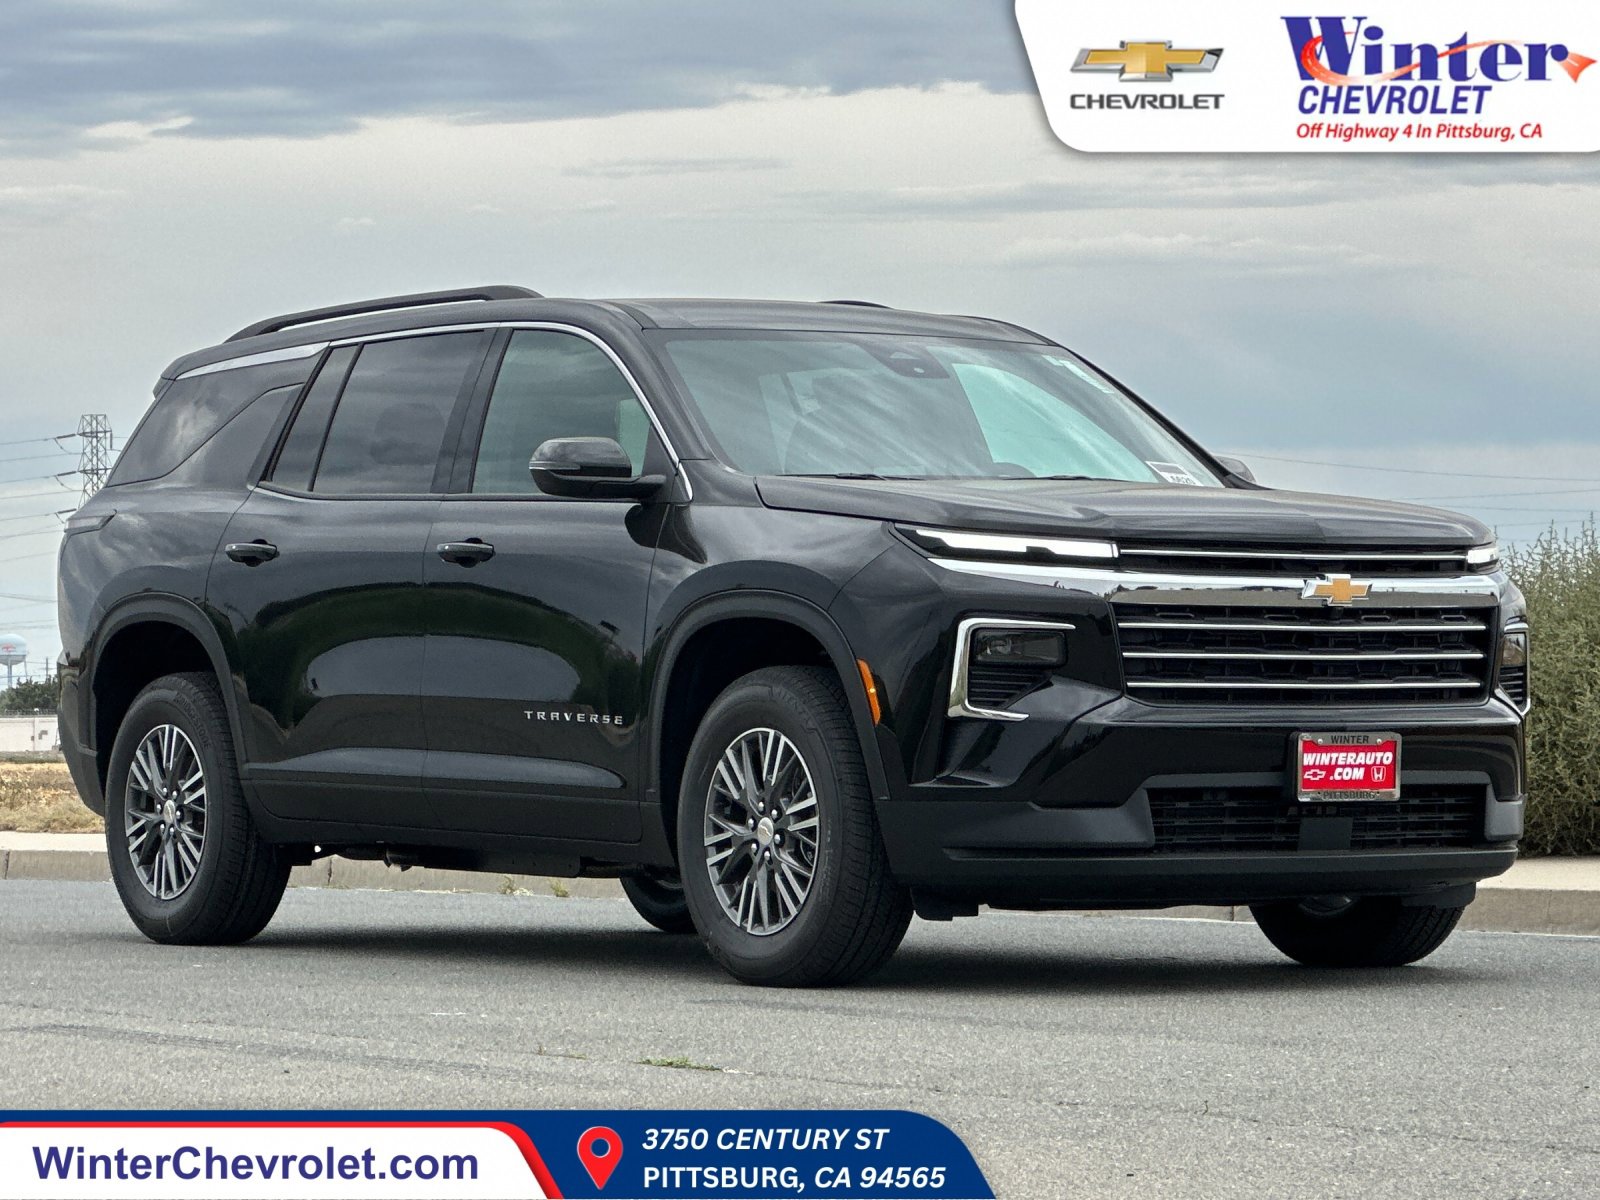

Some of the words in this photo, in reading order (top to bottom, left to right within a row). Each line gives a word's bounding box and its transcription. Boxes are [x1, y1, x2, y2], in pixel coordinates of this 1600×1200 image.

[523, 710, 623, 725] TRAVERSE
[1331, 735, 1369, 744] WINTER
[1303, 751, 1393, 766] WINTERAUTO
[1329, 767, 1365, 781] .COM
[1323, 790, 1376, 800] PITTSBURG
